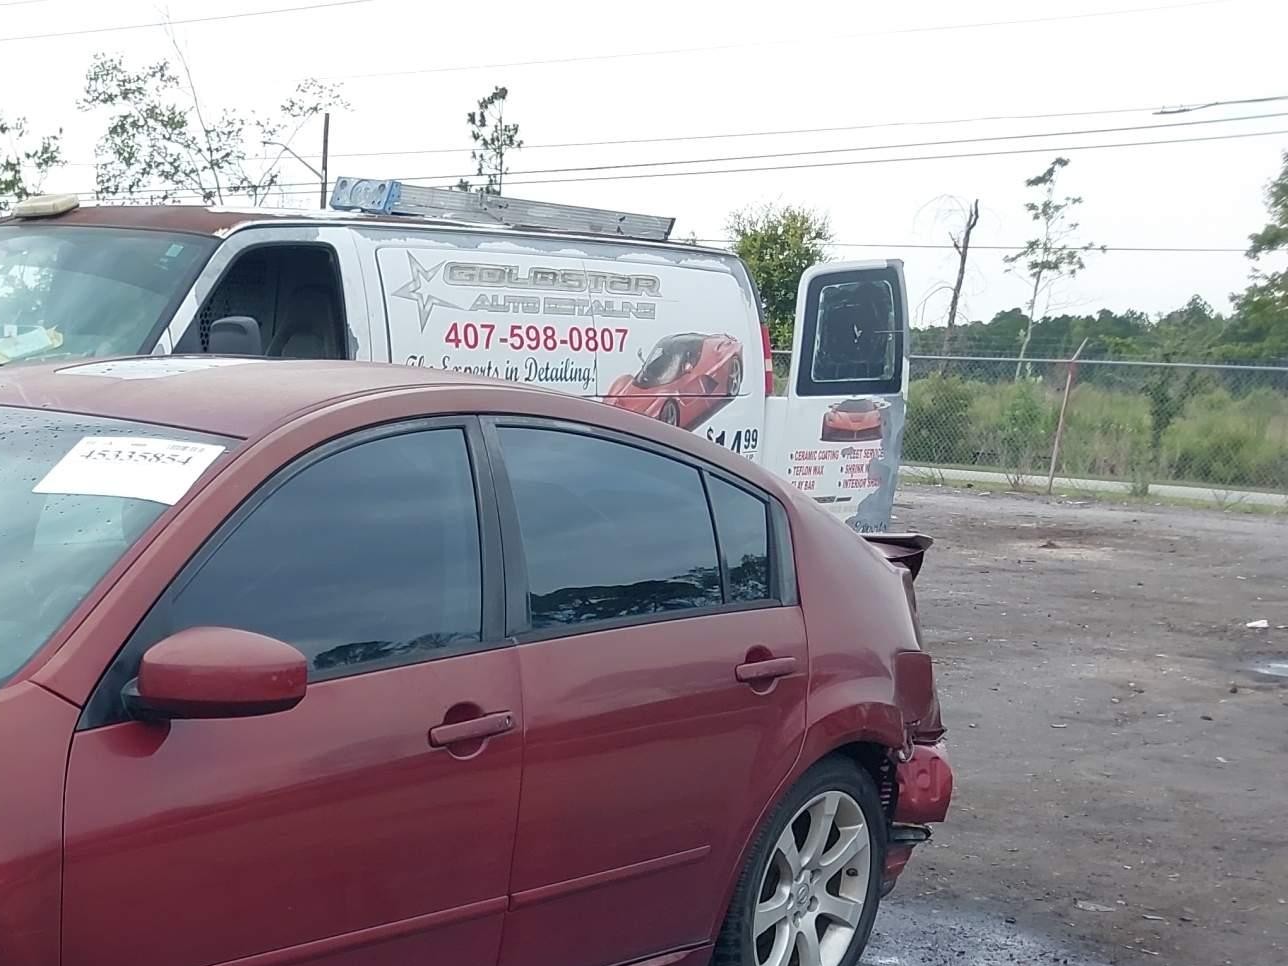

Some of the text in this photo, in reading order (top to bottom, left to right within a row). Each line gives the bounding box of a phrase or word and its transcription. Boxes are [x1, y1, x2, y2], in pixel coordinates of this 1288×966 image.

[469, 294, 540, 314] AUTO
[444, 322, 629, 353] 407-598-0807
[406, 355, 433, 368] Th
[505, 360, 520, 381] in
[524, 357, 597, 389] Detailing!
[794, 450, 817, 461] CERAMIC
[793, 466, 812, 476] TEFLON
